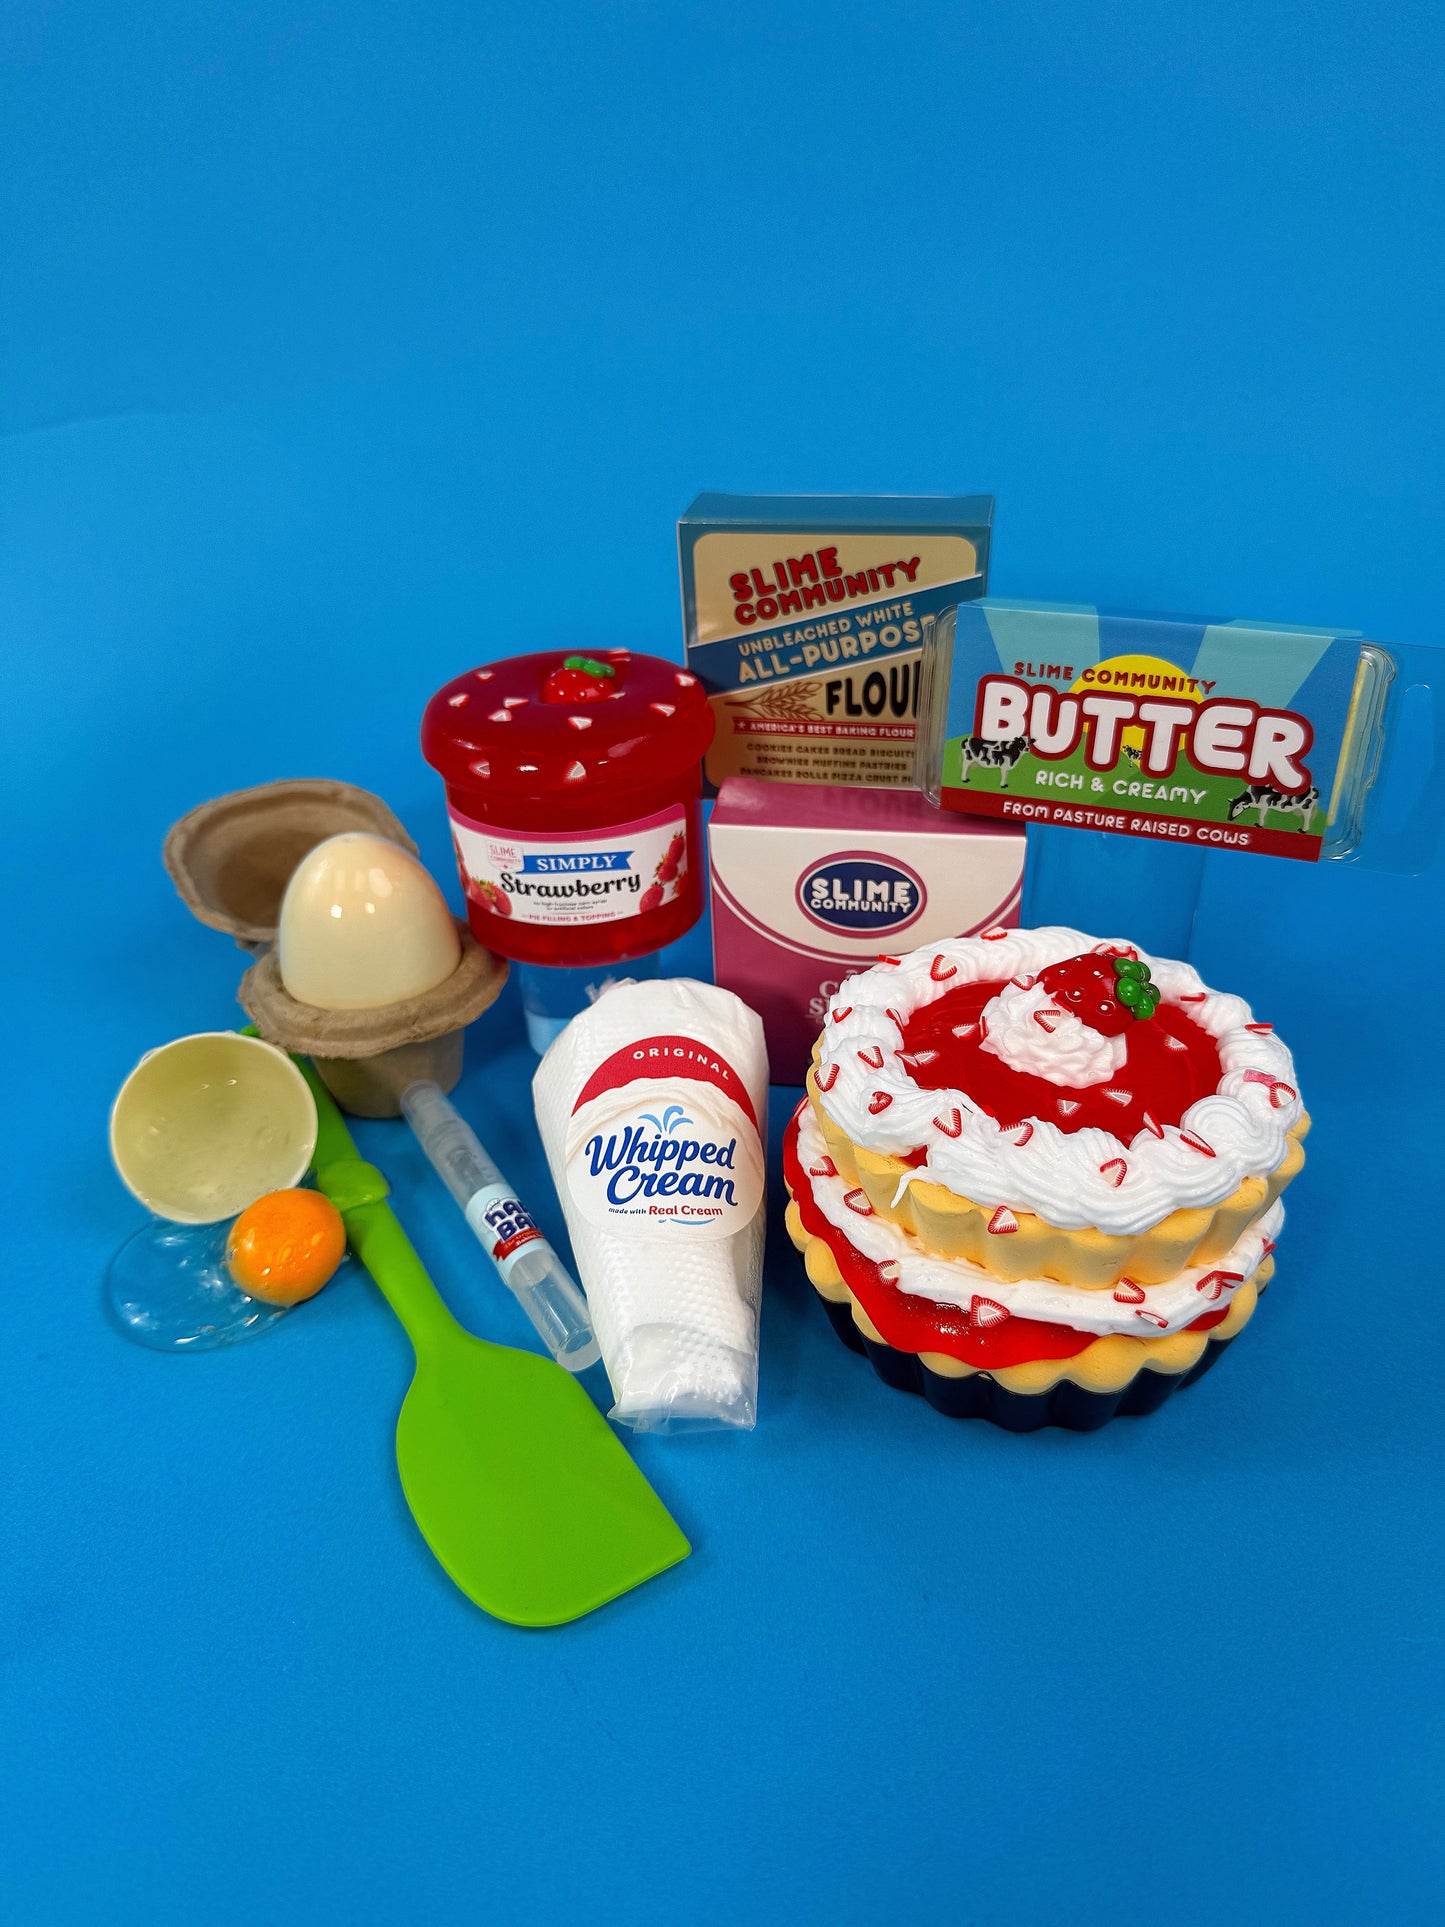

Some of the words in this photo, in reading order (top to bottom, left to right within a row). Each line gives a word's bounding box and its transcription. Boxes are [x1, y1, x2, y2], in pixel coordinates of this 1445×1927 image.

[729, 547, 843, 601] SLIME
[735, 557, 921, 625] COMMUNITY
[738, 618, 851, 656] UNBLEACHED
[855, 601, 914, 628] WHITE
[825, 660, 920, 718] FLOU
[1014, 661, 1074, 681] SLIME
[1081, 668, 1217, 694] COMMUNITY
[750, 722, 804, 733] AMERICA'S
[807, 725, 833, 735] BEST
[836, 726, 877, 736] BAKING
[879, 728, 914, 738] FLOUR
[979, 678, 1310, 792] BUTTER
[746, 743, 793, 752] COOKIES
[796, 746, 829, 755] CAKES
[756, 756, 809, 767] BROWNIES
[831, 772, 862, 781] PIZZA
[1036, 770, 1084, 791] RICH
[1090, 778, 1105, 793] &
[1112, 779, 1207, 805] CREAMY
[1003, 801, 1049, 819] FROM
[1053, 807, 1125, 829] PASTURE
[1130, 817, 1191, 838] RAISED
[1196, 825, 1250, 846] COWS
[536, 855, 617, 872] SIMPLY
[500, 872, 641, 898] Strawberry
[811, 878, 912, 903] SLIME
[810, 898, 912, 913] COMMUNITY
[633, 1047, 730, 1081] ORIGINAL
[584, 1126, 736, 1177] Whipped
[606, 1165, 739, 1206] Cream
[608, 1207, 628, 1215] made
[630, 1207, 647, 1215] with
[648, 1205, 678, 1216] Real
[681, 1205, 723, 1216] Cream
